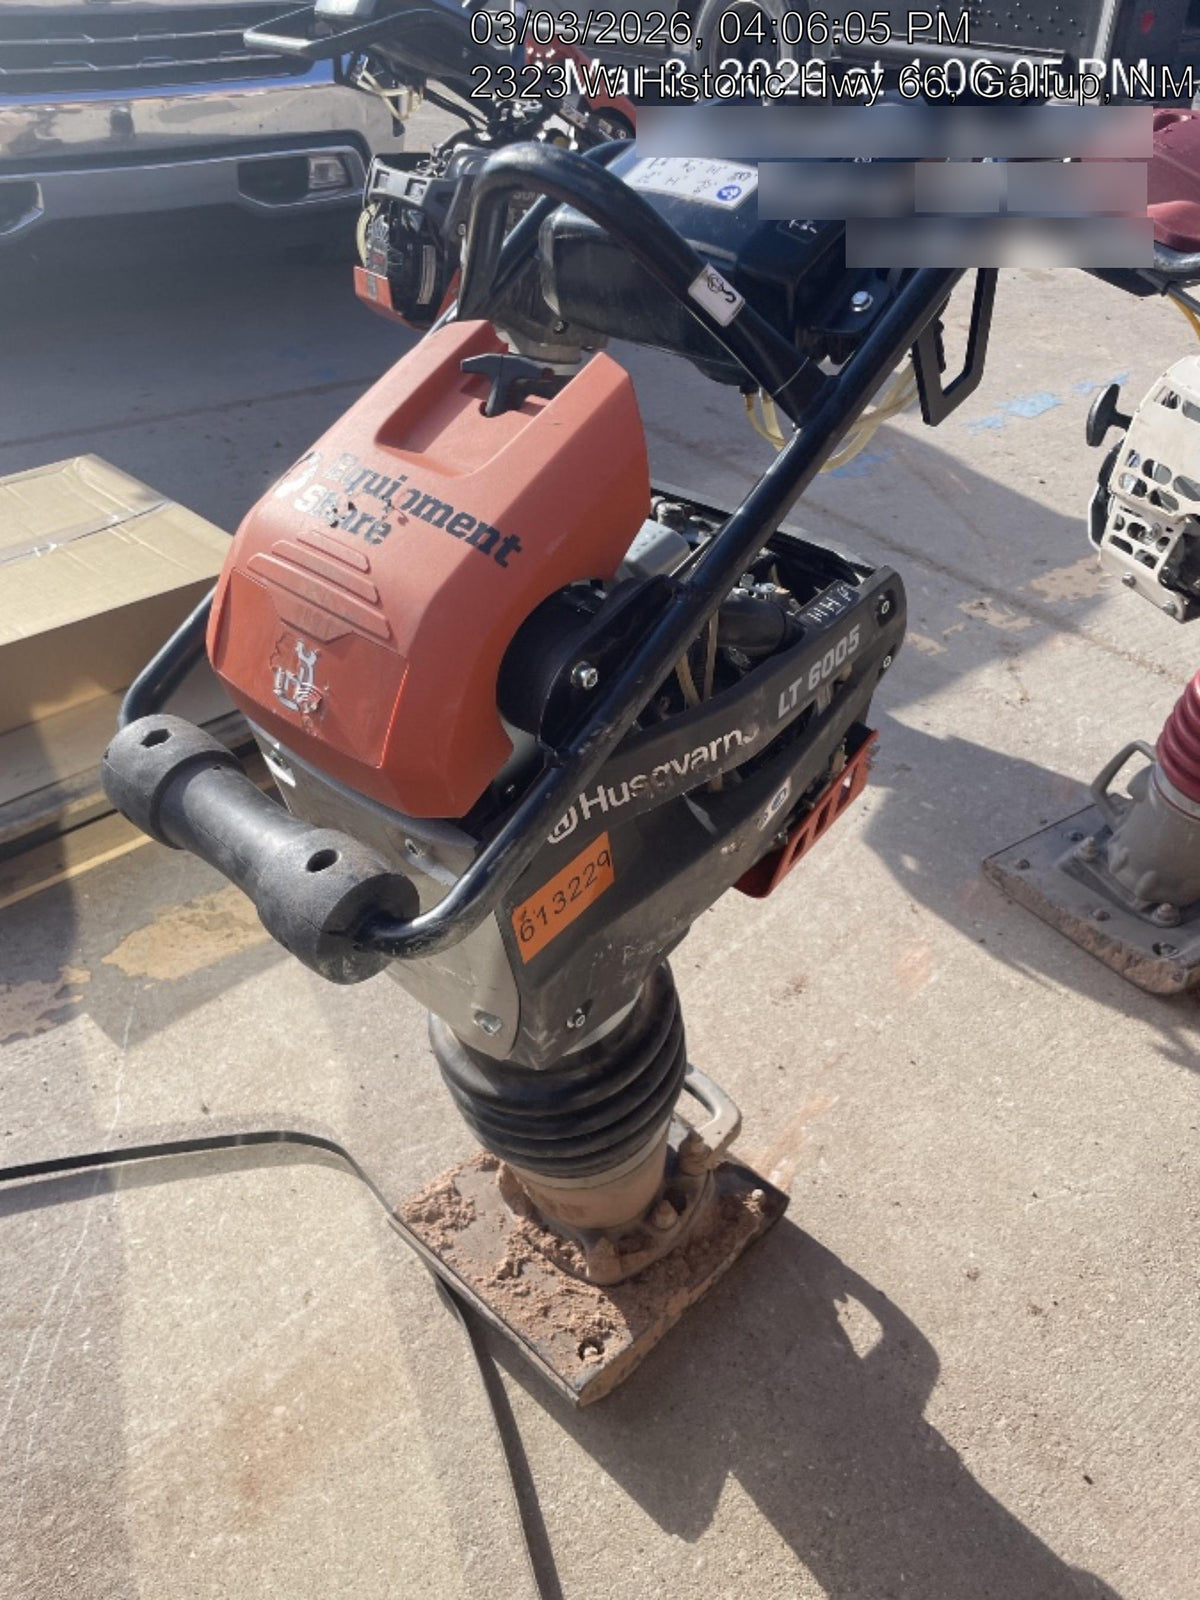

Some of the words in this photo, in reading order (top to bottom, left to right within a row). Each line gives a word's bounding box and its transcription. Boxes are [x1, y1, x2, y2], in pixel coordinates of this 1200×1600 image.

[778, 676, 803, 719] LT
[808, 623, 861, 691] 6005
[519, 849, 611, 943] 613229
